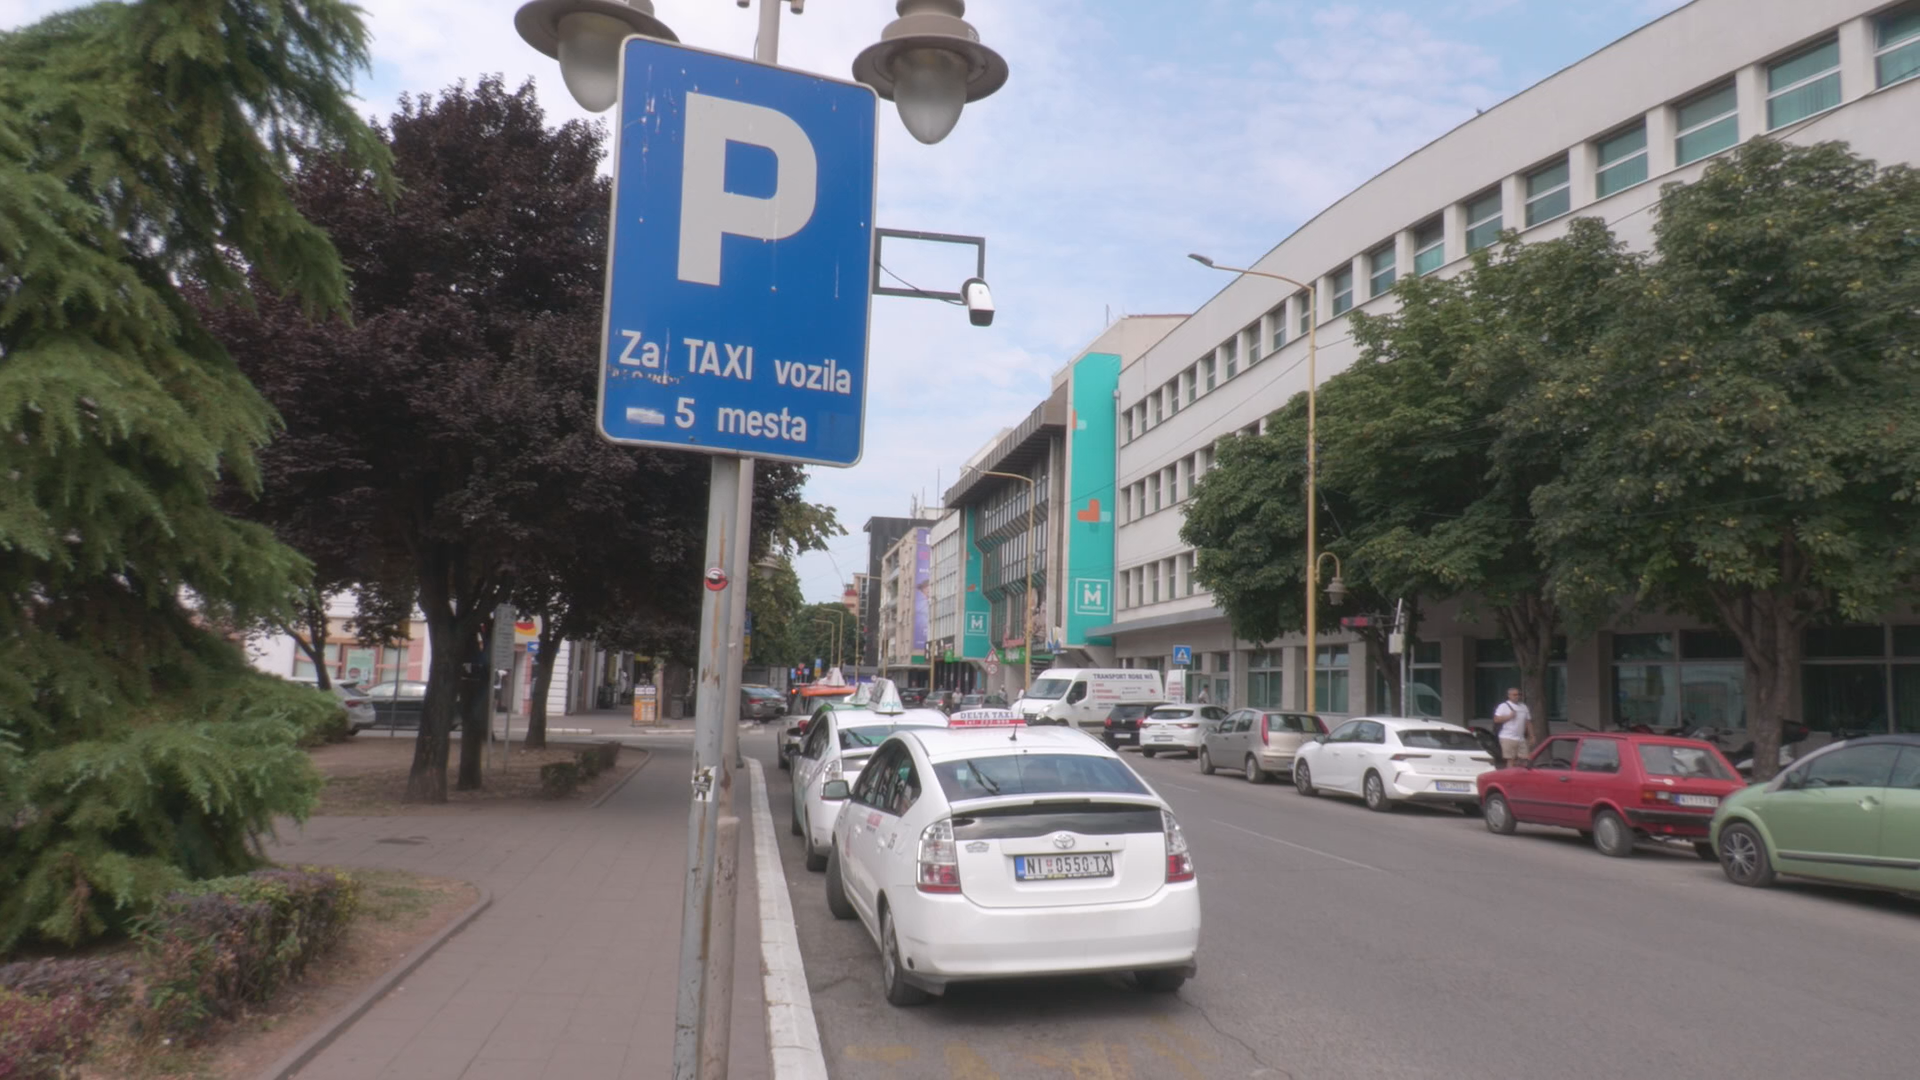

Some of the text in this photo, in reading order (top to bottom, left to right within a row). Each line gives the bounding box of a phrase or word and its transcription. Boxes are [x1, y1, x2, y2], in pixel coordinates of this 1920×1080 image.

[677, 91, 817, 286] P
[618, 329, 852, 395] Za TAXI vozila
[674, 397, 807, 442] 5 mesta
[1083, 583, 1102, 606] M
[1026, 857, 1042, 874] NI
